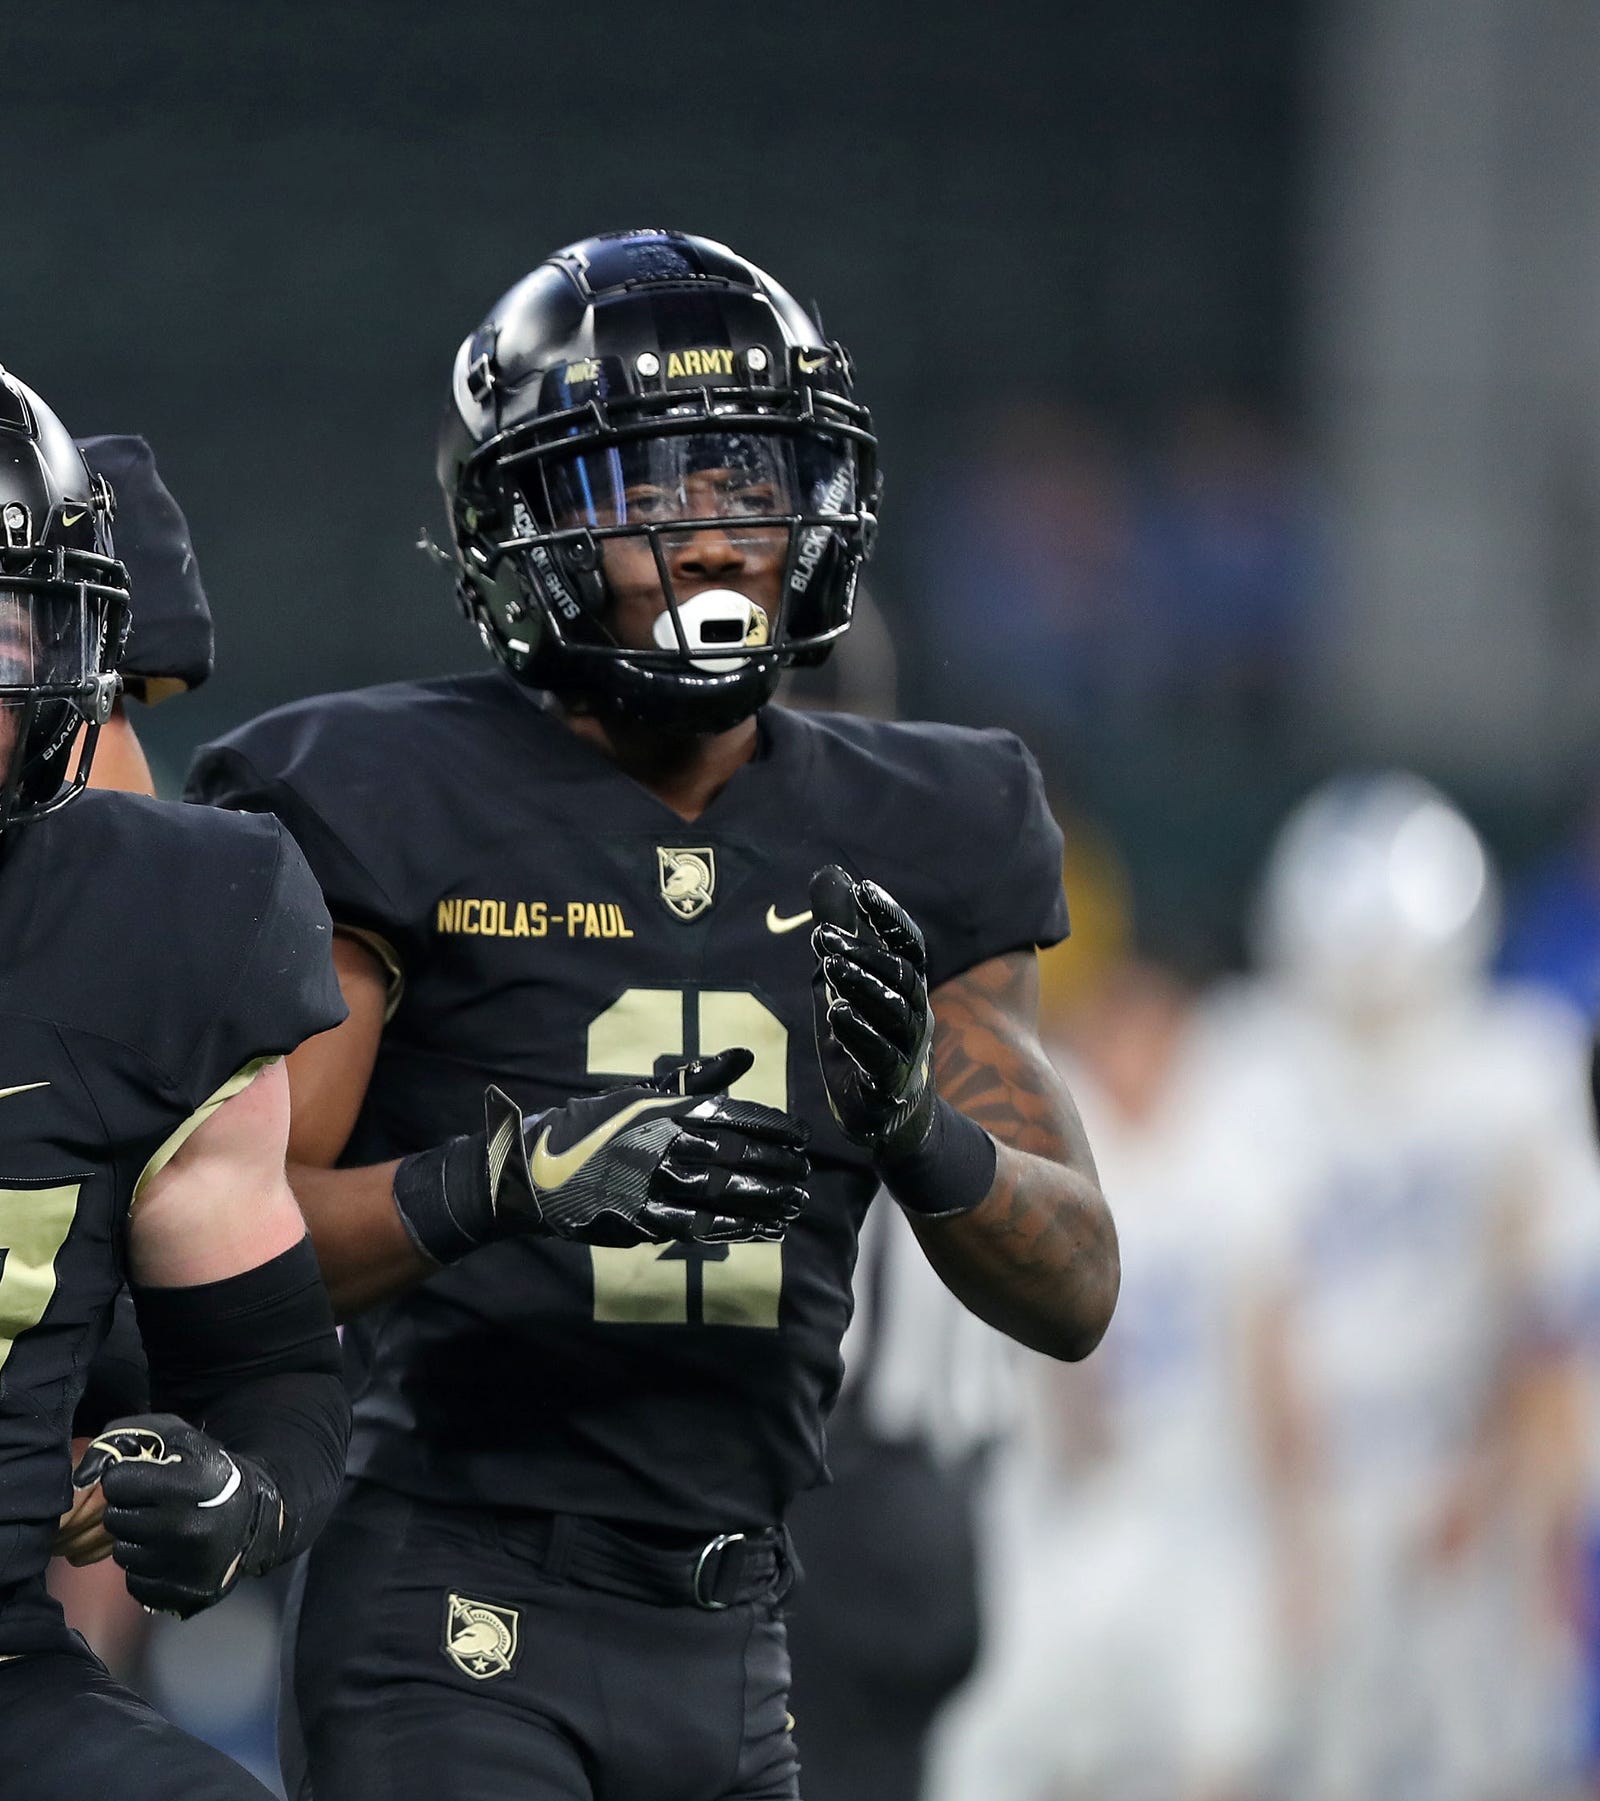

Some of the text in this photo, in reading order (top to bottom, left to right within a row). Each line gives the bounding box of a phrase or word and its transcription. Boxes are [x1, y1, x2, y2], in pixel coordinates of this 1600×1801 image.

[564, 359, 602, 384] NIKE
[668, 349, 734, 378] ARMY
[437, 898, 635, 938] NICOLAS-PAUL
